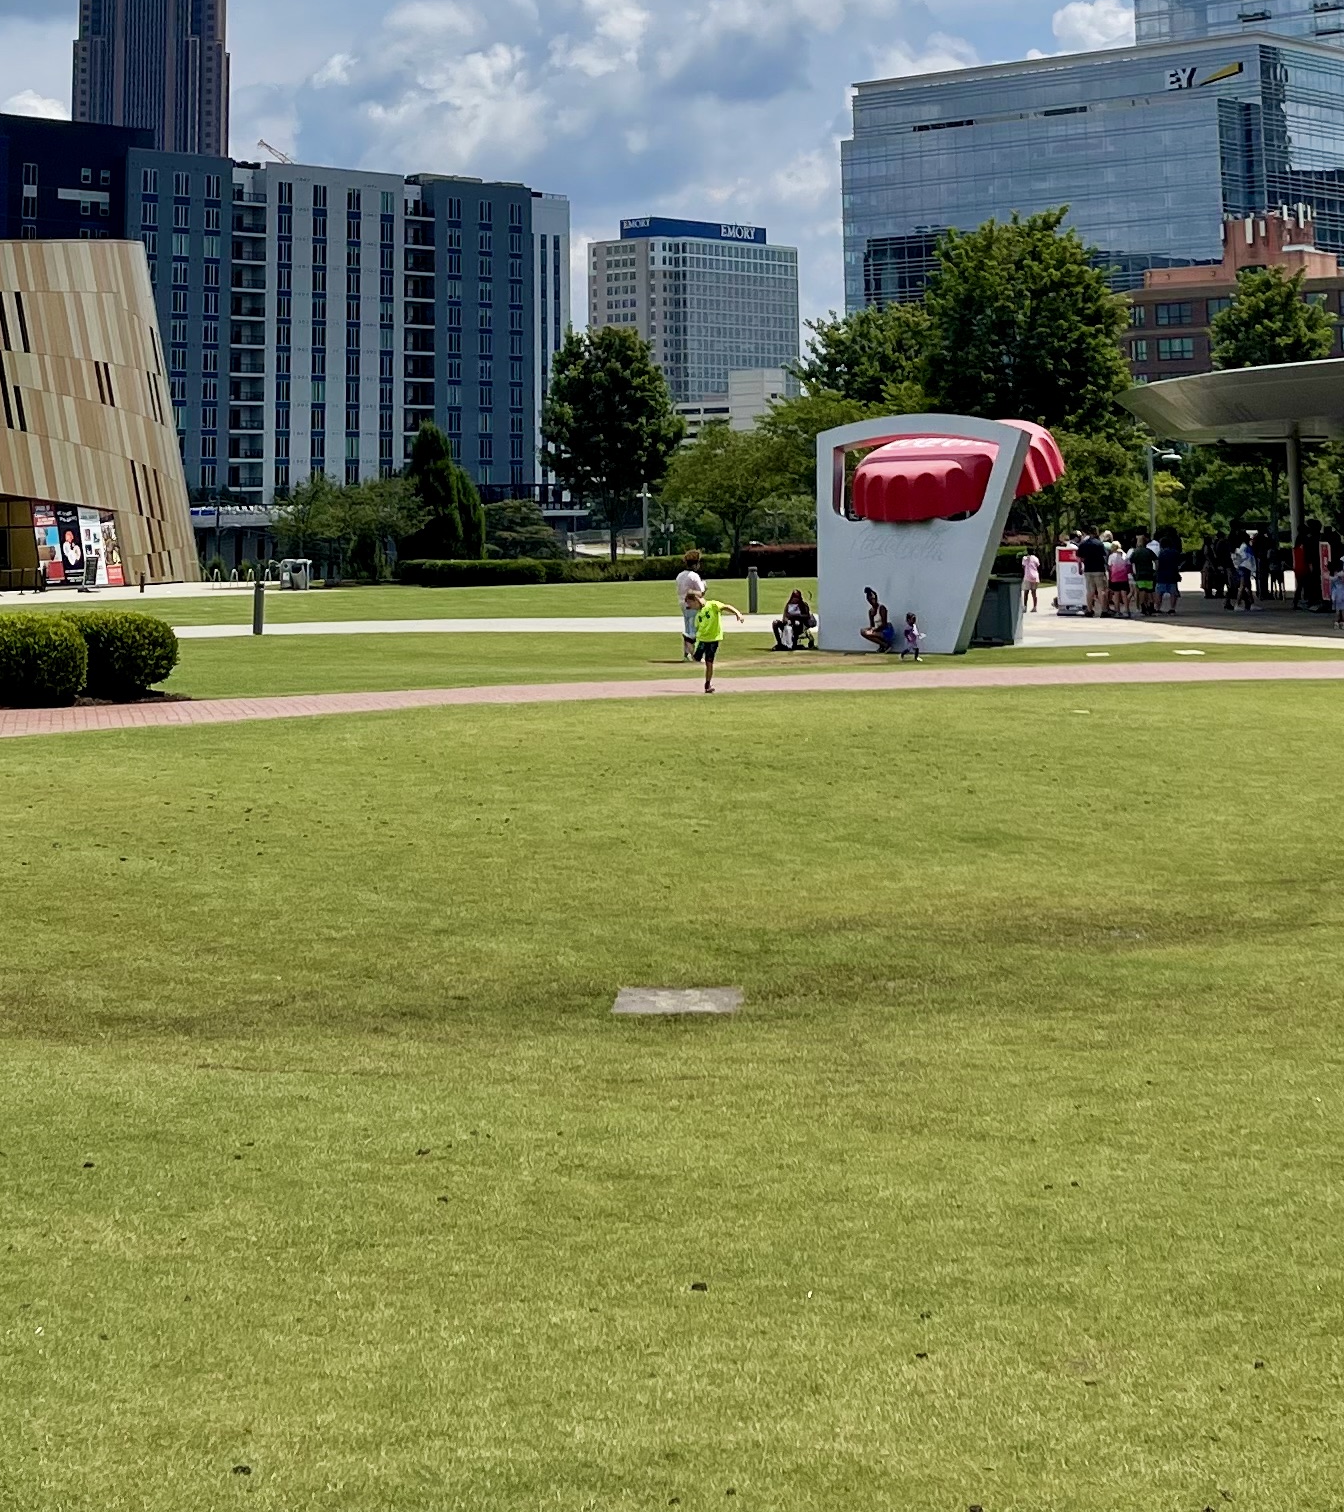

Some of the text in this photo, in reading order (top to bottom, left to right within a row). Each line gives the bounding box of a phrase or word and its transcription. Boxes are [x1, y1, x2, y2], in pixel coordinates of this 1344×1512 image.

[1164, 67, 1193, 89] EY
[623, 218, 650, 230] EMORY
[720, 224, 756, 240] EMORY
